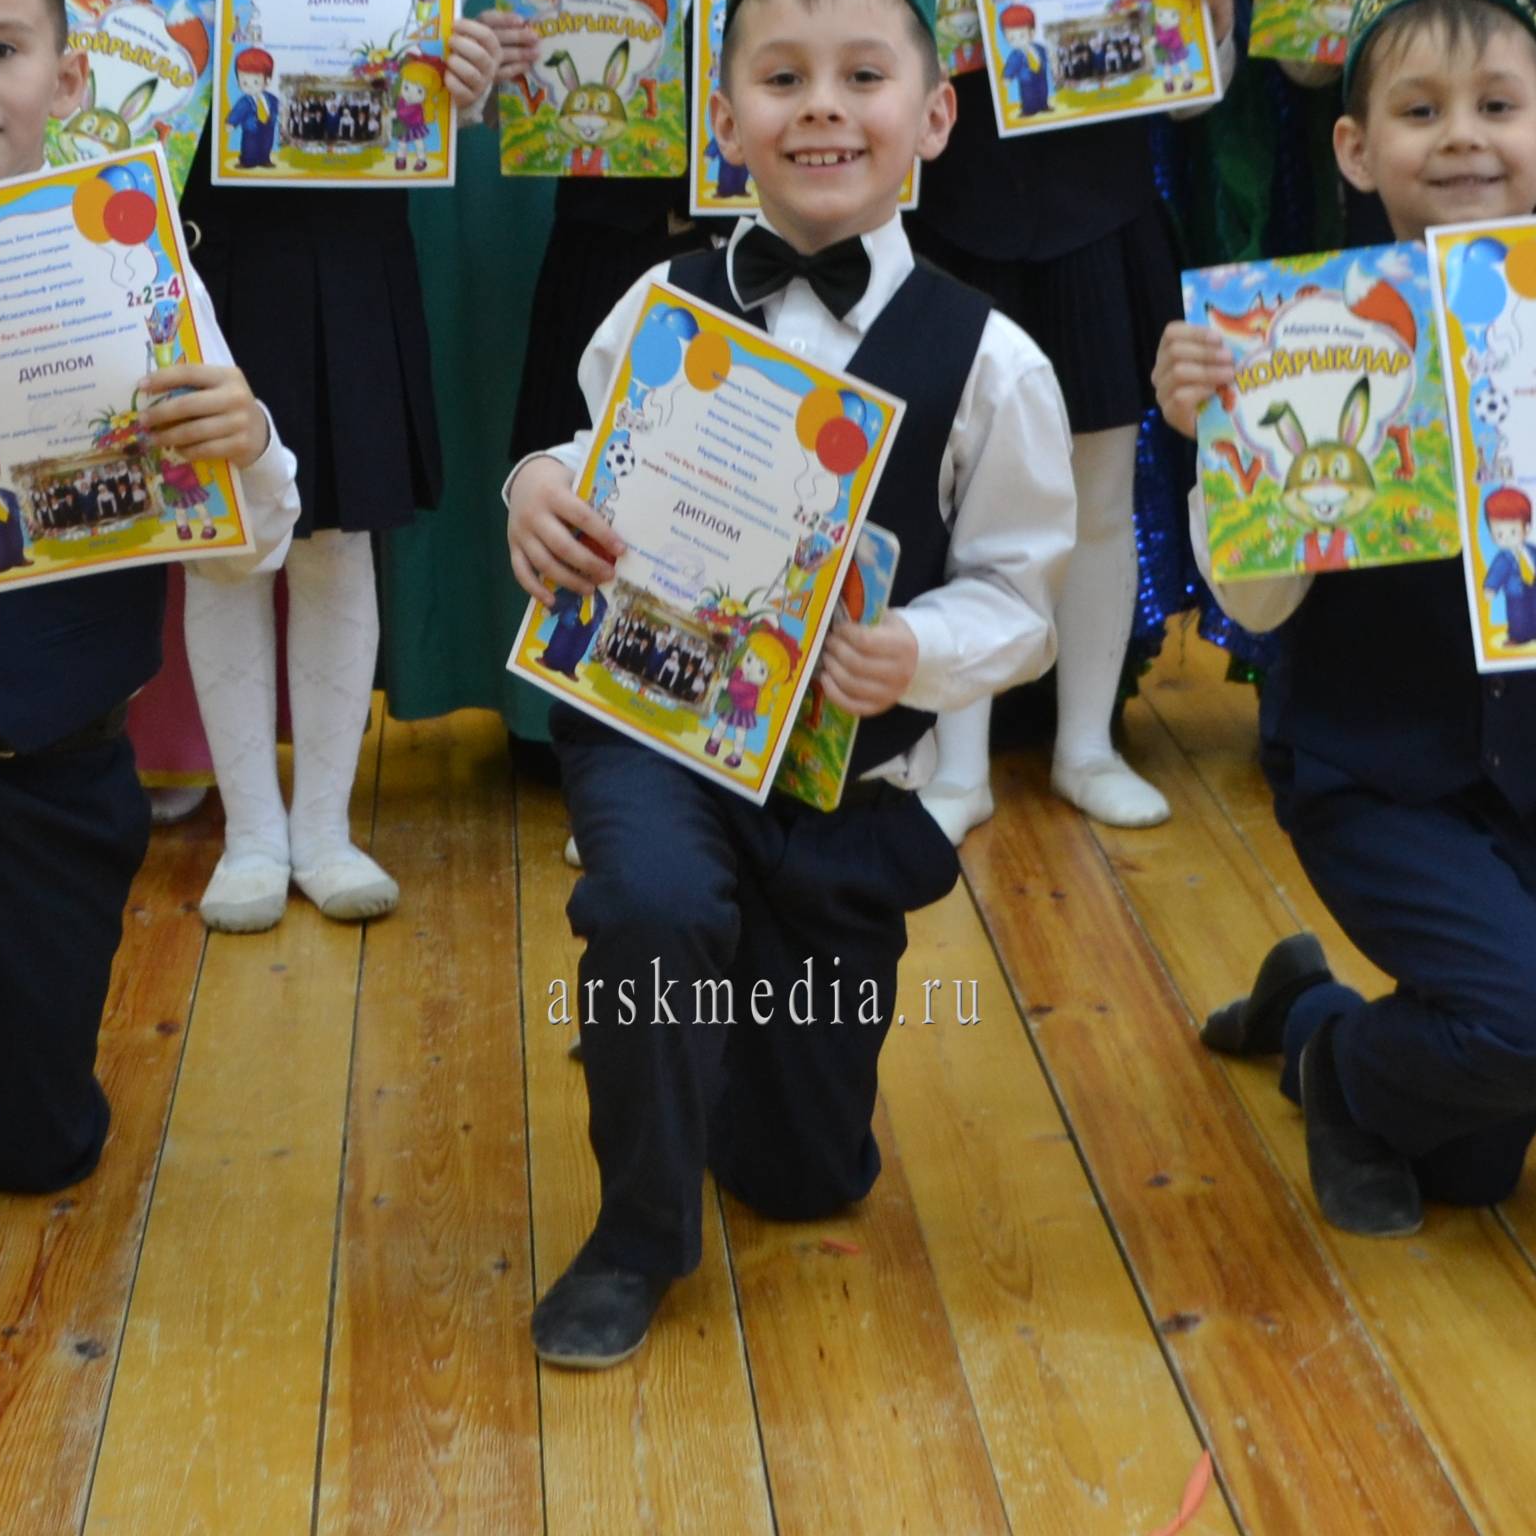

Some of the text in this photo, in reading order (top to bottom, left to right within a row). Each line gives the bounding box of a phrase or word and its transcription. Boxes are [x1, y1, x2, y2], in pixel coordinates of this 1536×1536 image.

[17, 354, 95, 384] ДИПЛОМ
[1235, 344, 1412, 395] КОЙРЫКЛАР
[672, 498, 742, 544] ДИПЛОМ
